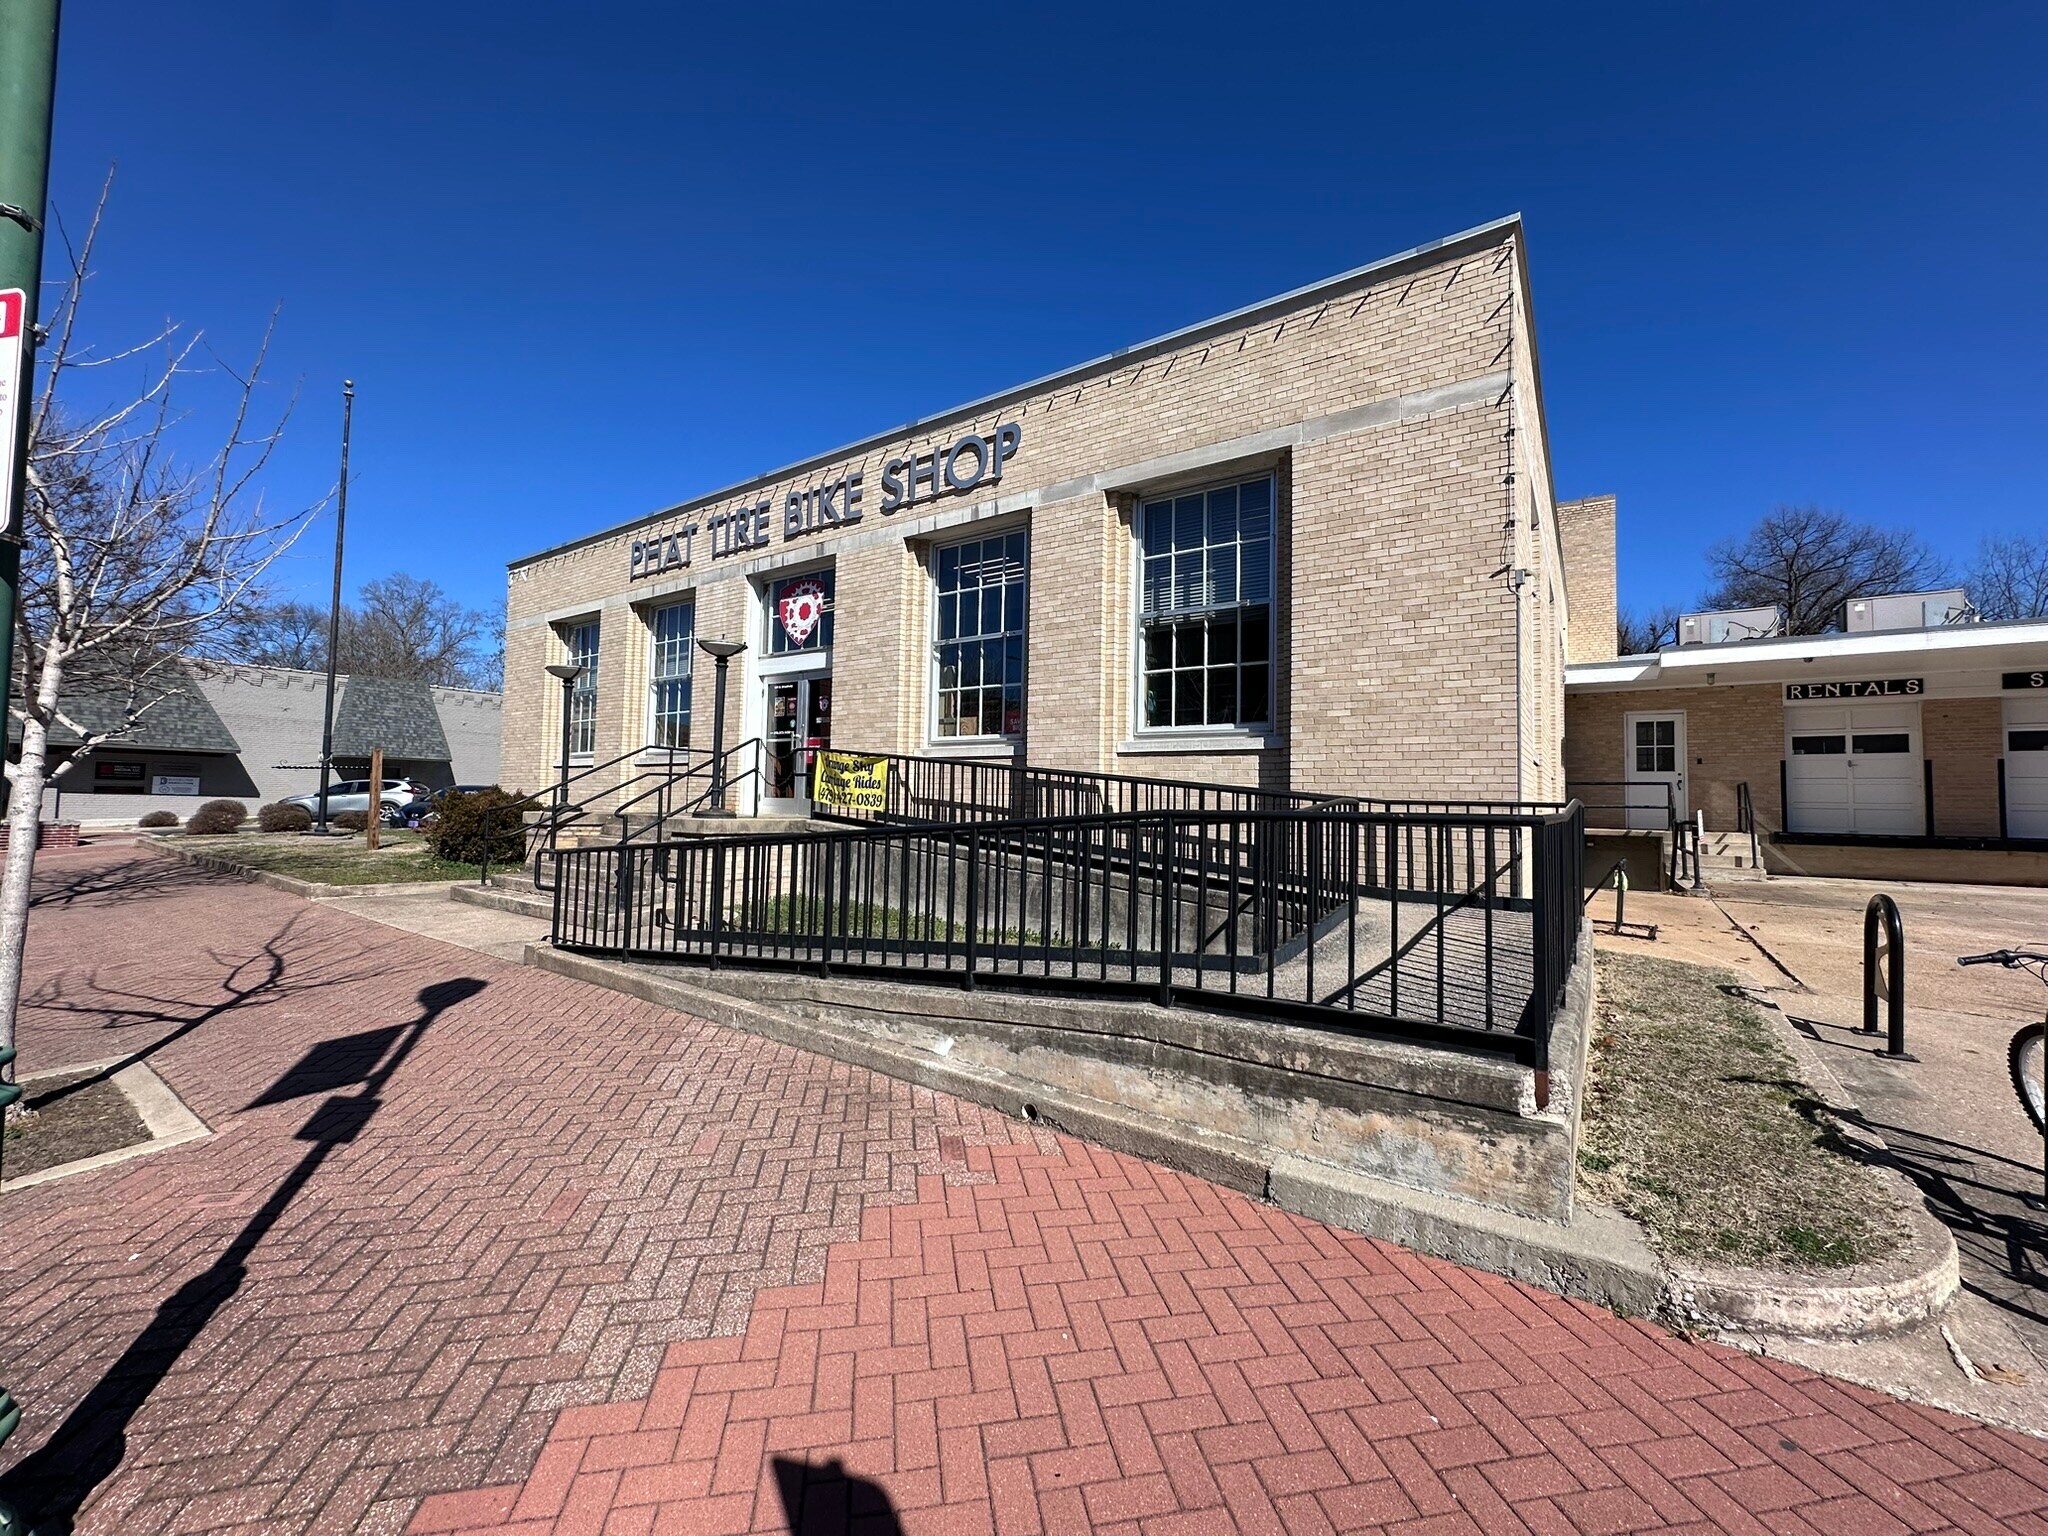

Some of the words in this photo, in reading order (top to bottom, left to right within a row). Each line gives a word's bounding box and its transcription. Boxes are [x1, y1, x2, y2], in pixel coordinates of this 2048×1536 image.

[630, 523, 697, 580] PHAT
[708, 501, 770, 558] TIRE
[784, 472, 863, 537] BIKE
[881, 423, 1021, 511] SHOP
[1791, 680, 1919, 699] RENTALS
[852, 775, 881, 790] Rides
